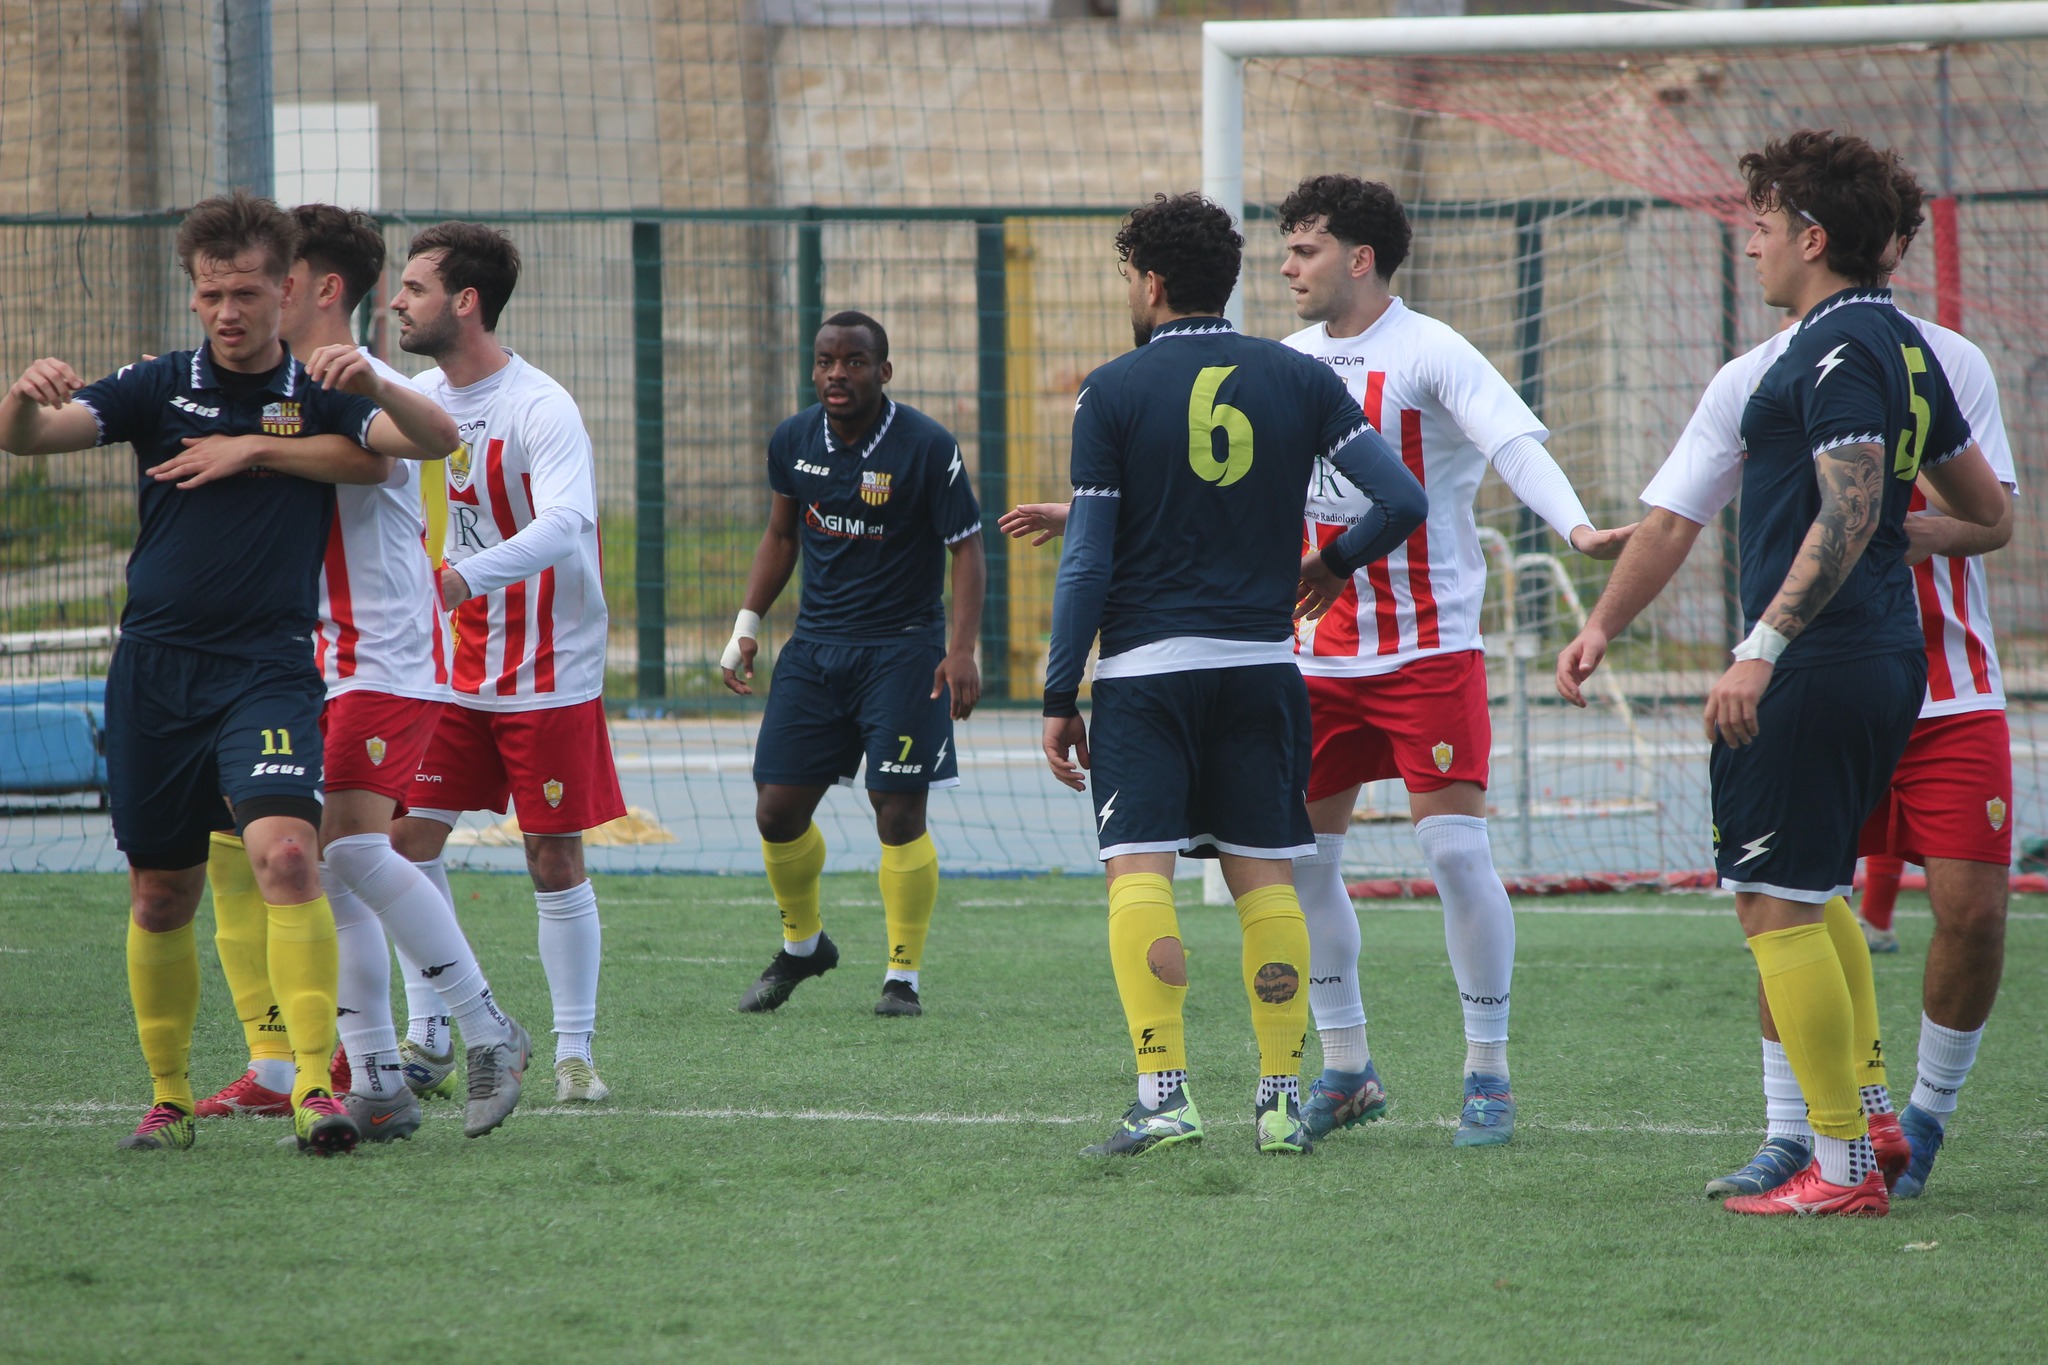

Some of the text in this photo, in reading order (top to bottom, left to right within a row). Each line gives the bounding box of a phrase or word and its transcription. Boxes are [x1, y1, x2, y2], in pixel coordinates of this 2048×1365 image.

[169, 396, 220, 418] Zeus
[1894, 343, 1932, 481] 5
[1188, 364, 1254, 487] 6
[794, 459, 831, 477] Zeus
[261, 728, 293, 756] 11
[899, 735, 914, 762] 7
[250, 762, 305, 777] Zeus
[879, 761, 922, 774] Zeus
[1138, 1045, 1167, 1055] ZEUS
